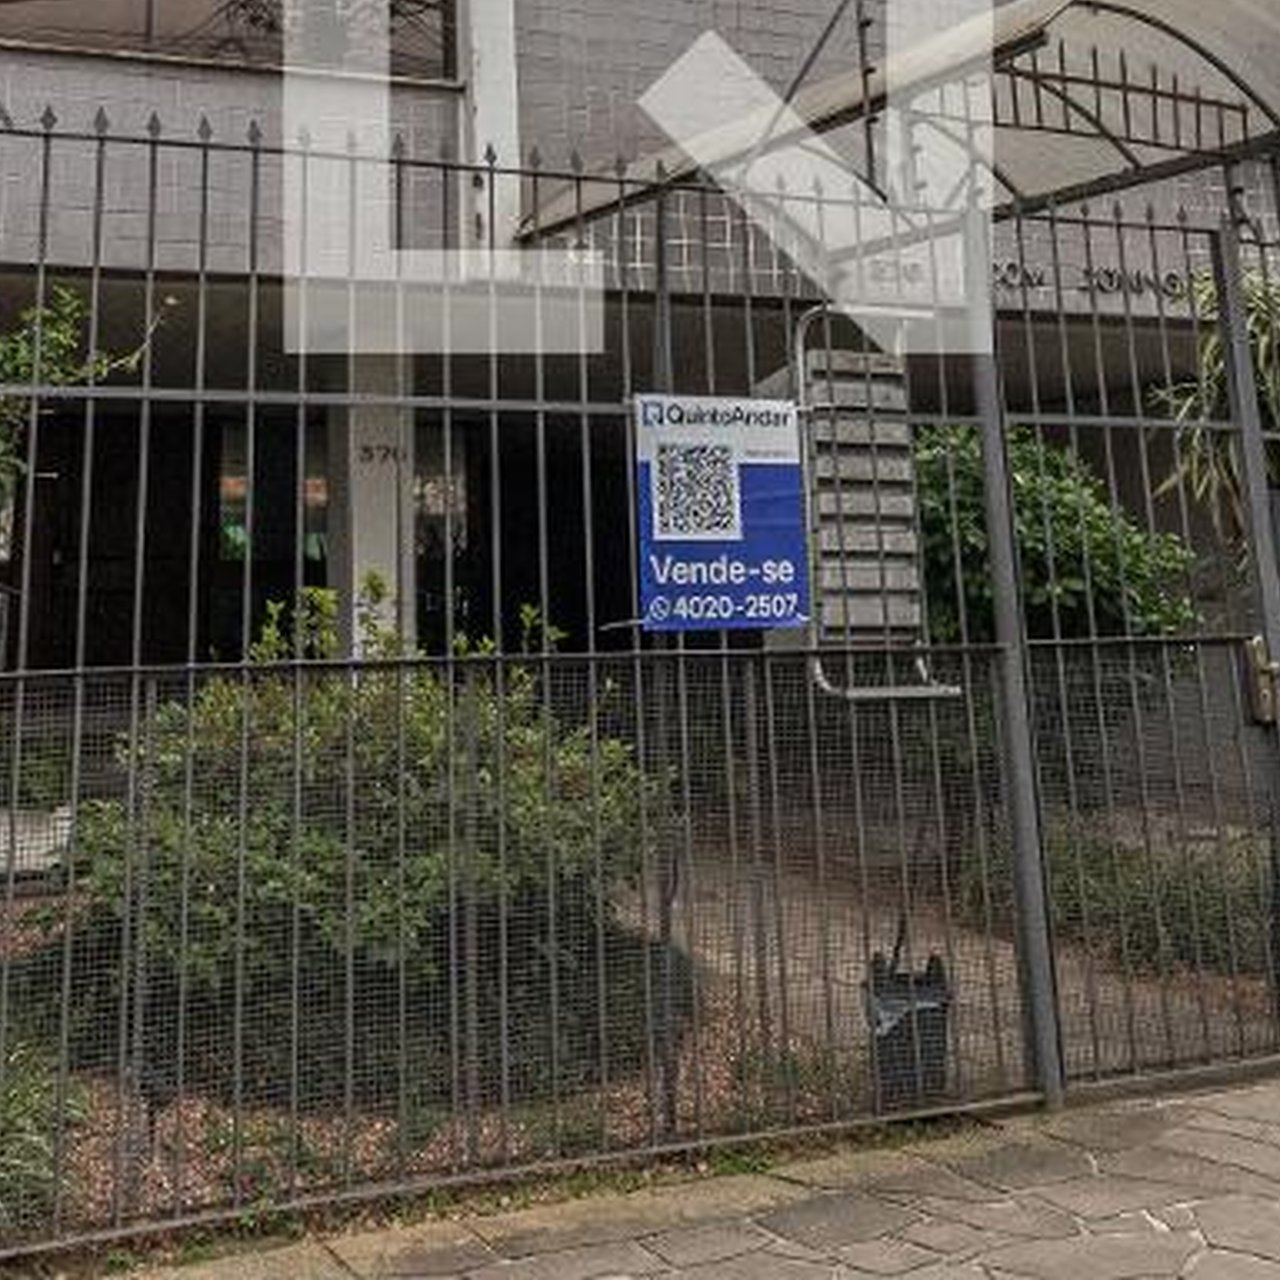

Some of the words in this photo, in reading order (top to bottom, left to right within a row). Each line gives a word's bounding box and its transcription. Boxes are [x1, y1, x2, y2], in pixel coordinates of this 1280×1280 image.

[666, 402, 790, 427] QuintoAndar
[649, 554, 795, 584] Vende-se
[673, 593, 798, 619] 4020-2507
